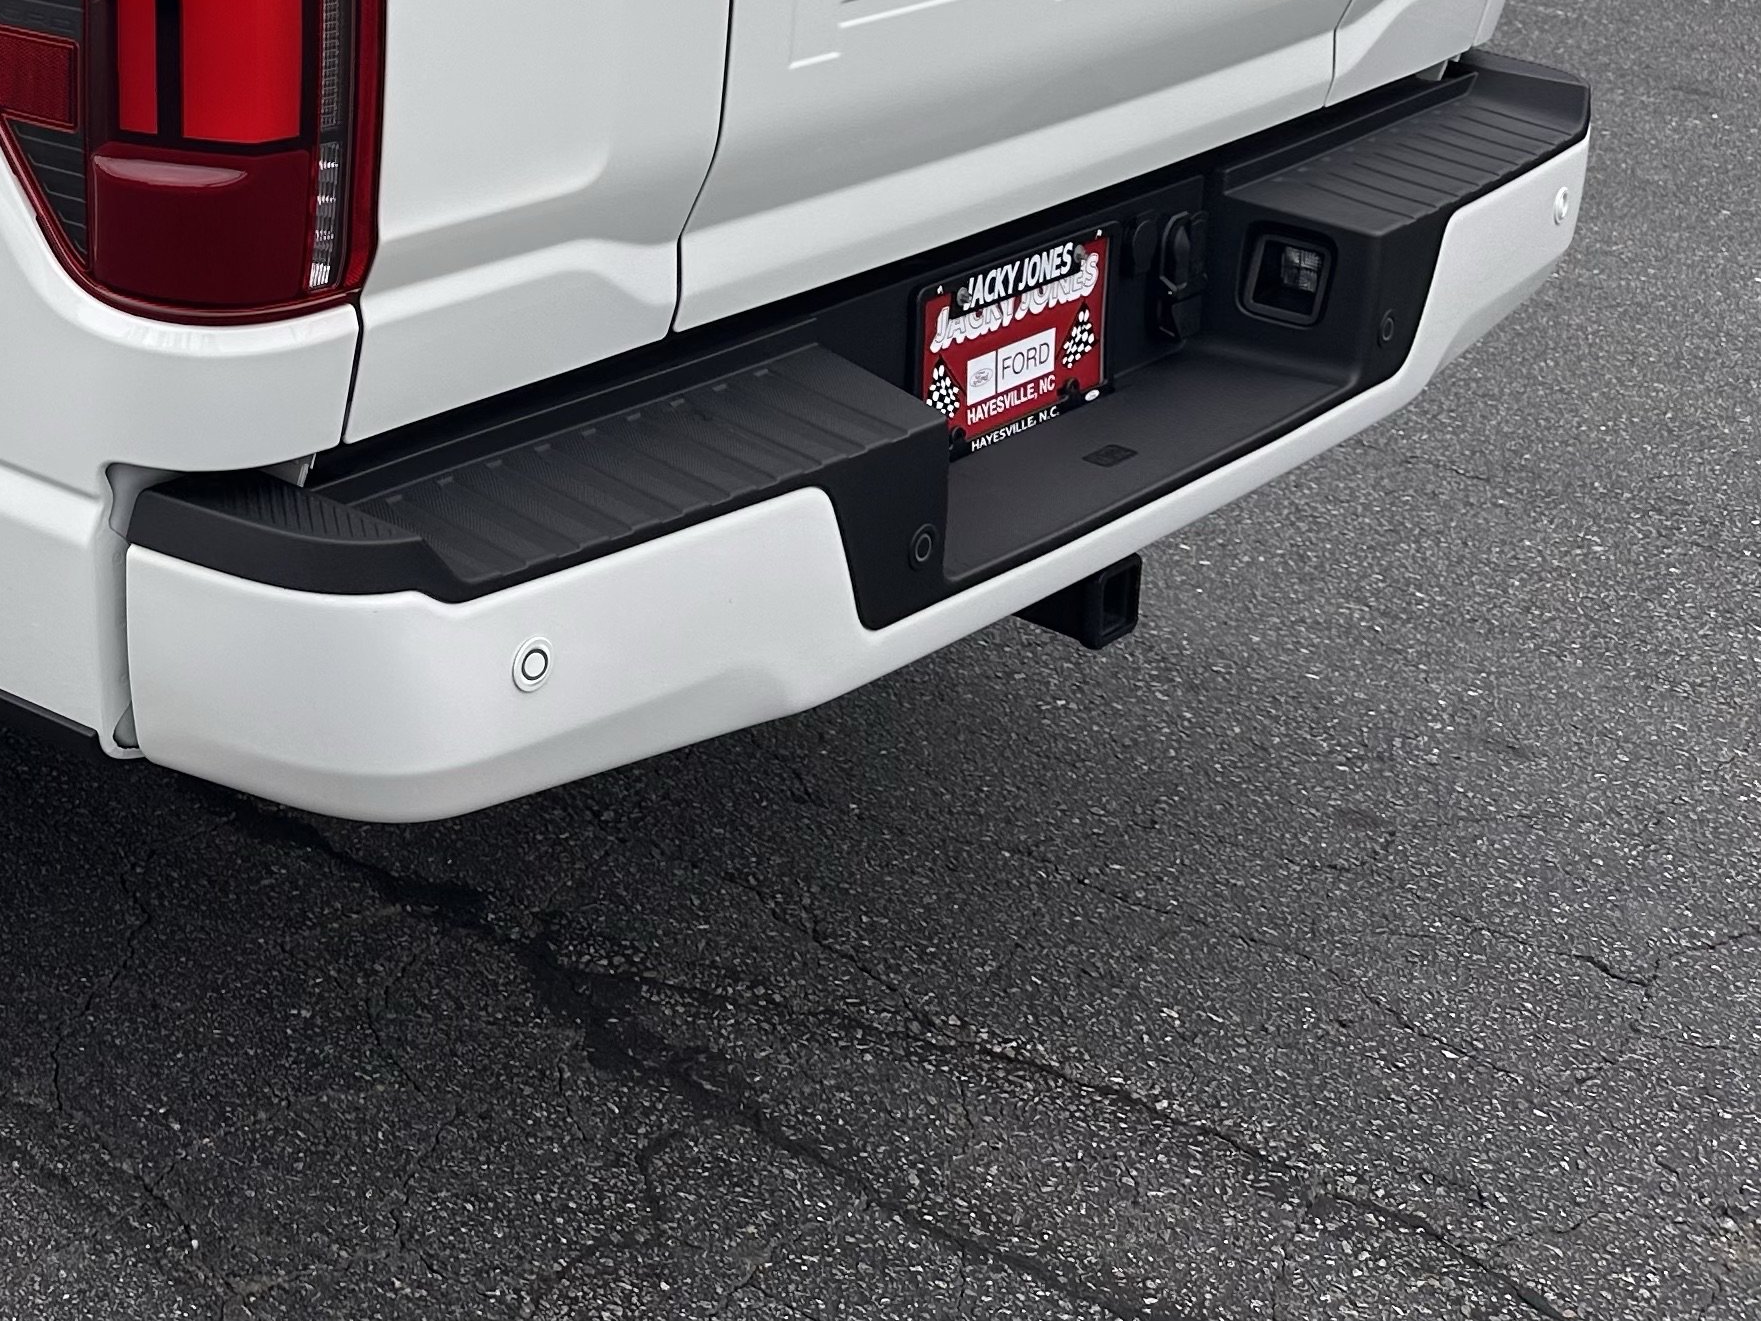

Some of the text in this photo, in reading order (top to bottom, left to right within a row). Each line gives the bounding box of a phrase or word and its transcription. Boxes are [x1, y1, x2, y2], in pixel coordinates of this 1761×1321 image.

[962, 241, 1074, 311] JACKY JONES
[1001, 341, 1051, 380] FORD
[966, 374, 1057, 426] HAYESVILLE, NC
[971, 405, 1061, 452] HAYESVILLE, N.C.
